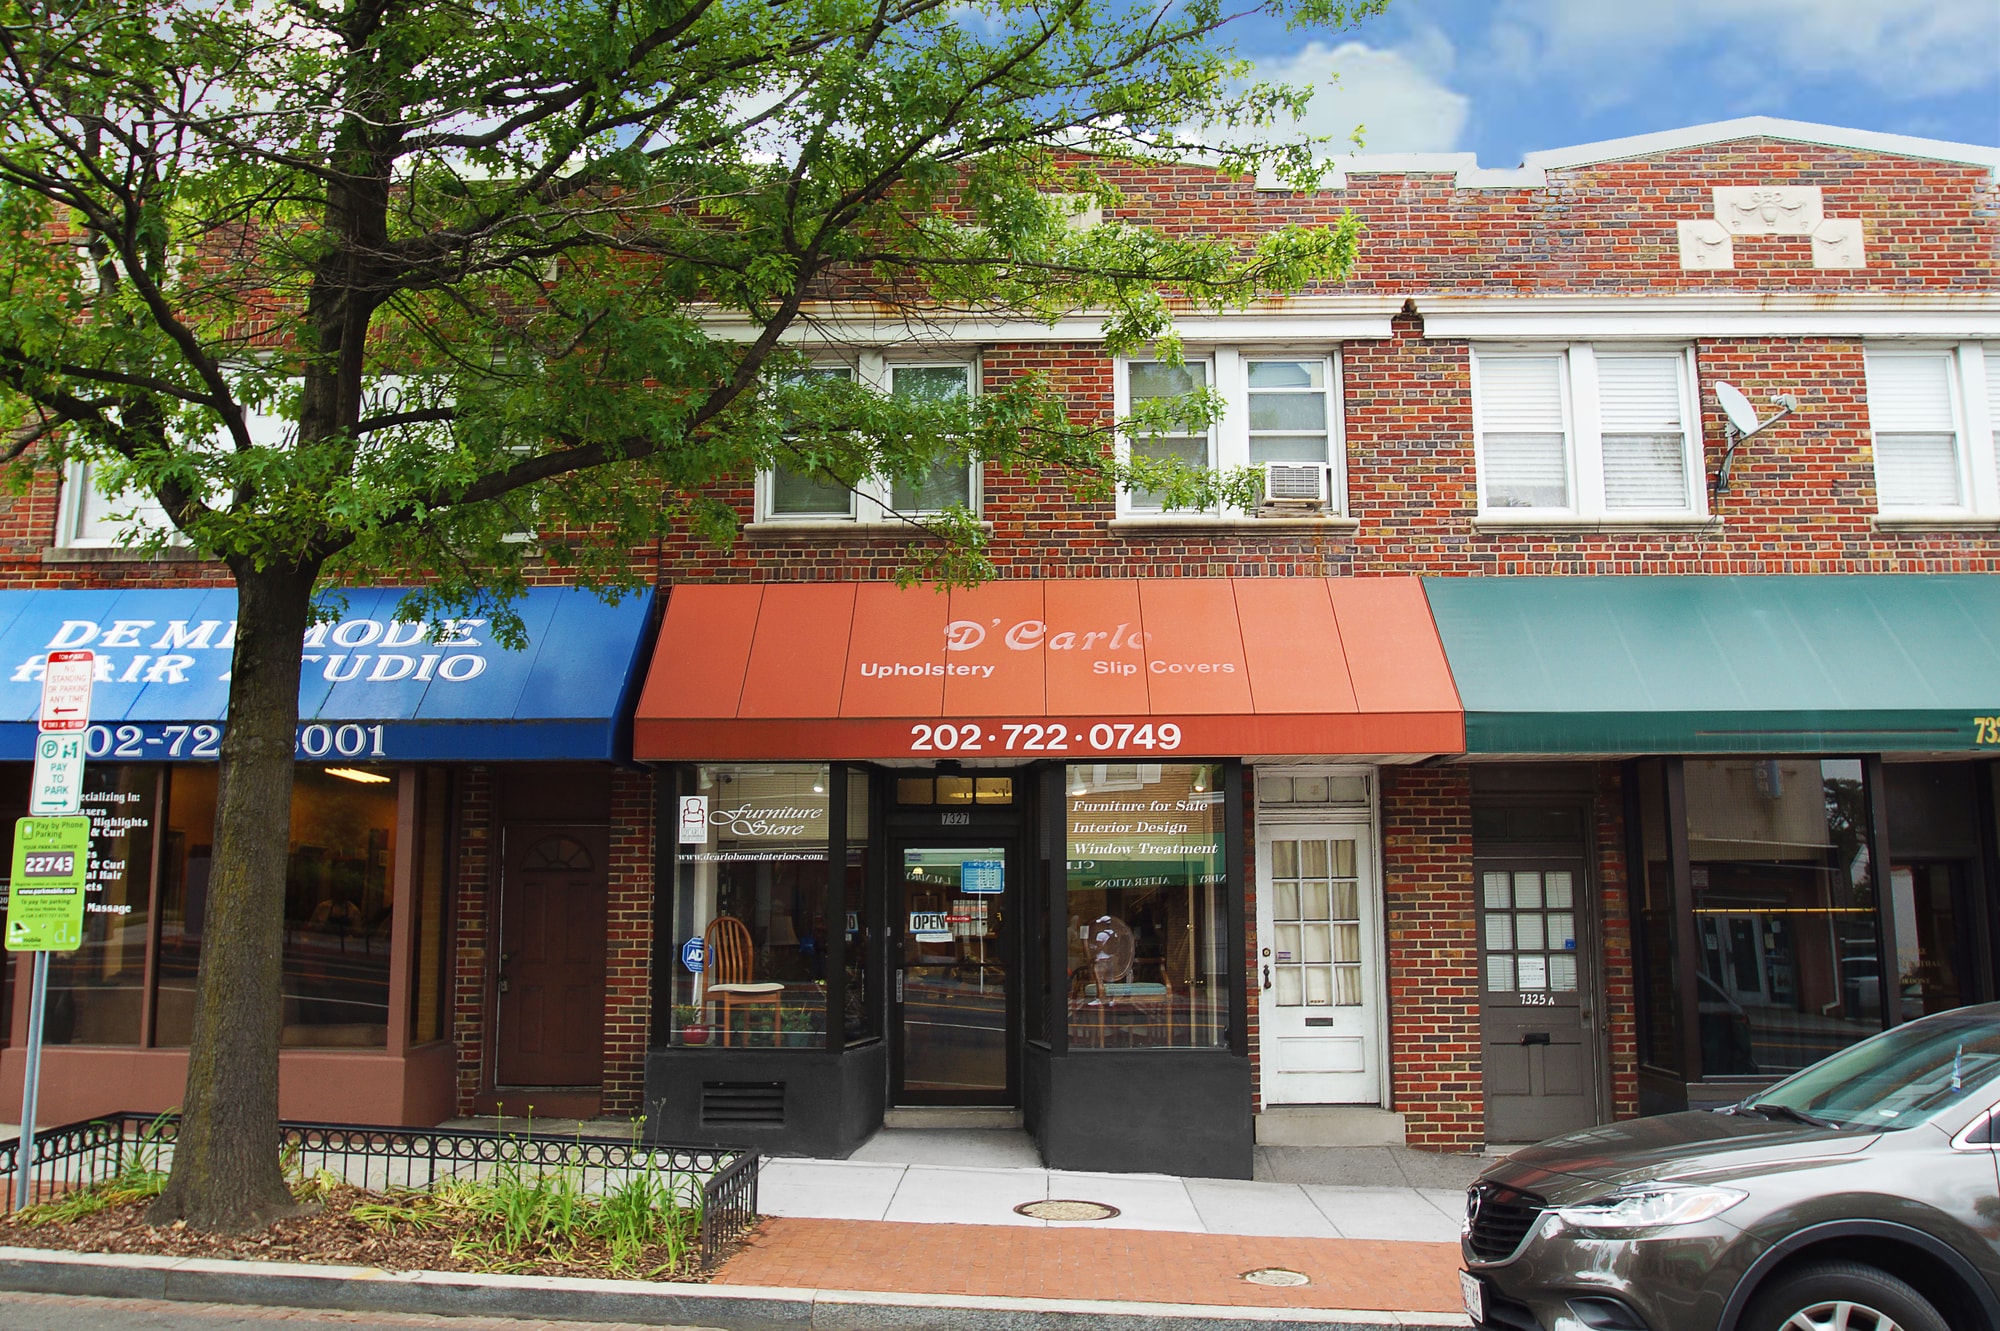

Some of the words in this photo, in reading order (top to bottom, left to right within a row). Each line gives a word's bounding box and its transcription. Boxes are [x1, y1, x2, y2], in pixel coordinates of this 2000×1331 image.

[44, 620, 238, 649] DEMI
[942, 617, 1152, 652] D'Carlo
[219, 654, 487, 682] UDIO
[860, 663, 995, 678] Upholstery
[1092, 660, 1138, 676] Slip
[1149, 660, 1235, 674] Covers
[51, 674, 87, 684] STANDING
[48, 685, 57, 693] OR
[60, 684, 88, 693] PARKING
[50, 695, 65, 704] ANY
[69, 694, 85, 703] TIME
[51, 763, 68, 772] PAY
[53, 774, 65, 783] TO
[44, 786, 69, 795] PARK
[80, 792, 125, 804] ecializing
[127, 792, 140, 802] In:
[1072, 800, 1145, 812] Furniture
[1149, 800, 1172, 812] for
[1175, 800, 1208, 812] Sale
[708, 803, 824, 825] Furniture
[942, 813, 969, 825] 7327
[36, 822, 49, 830] Pay
[51, 821, 59, 829] by
[61, 821, 84, 829] Phone
[93, 817, 148, 828] Highlights
[731, 819, 805, 836] Store
[1072, 822, 1133, 833] Interior
[1135, 821, 1188, 835] Design
[35, 830, 62, 839] Parking
[90, 828, 100, 837] &
[102, 828, 125, 837] Curl
[1074, 843, 1134, 854] Window
[1138, 842, 1219, 854] Treatment
[677, 852, 824, 861] www.dcarlohomeinteriors.com
[25, 856, 74, 873] 22743
[90, 860, 100, 869] &
[102, 860, 125, 869] Curl
[99, 871, 122, 880] Hair
[86, 903, 132, 915] Massage
[913, 914, 945, 930] OPEN
[1520, 993, 1546, 1005] 7325
